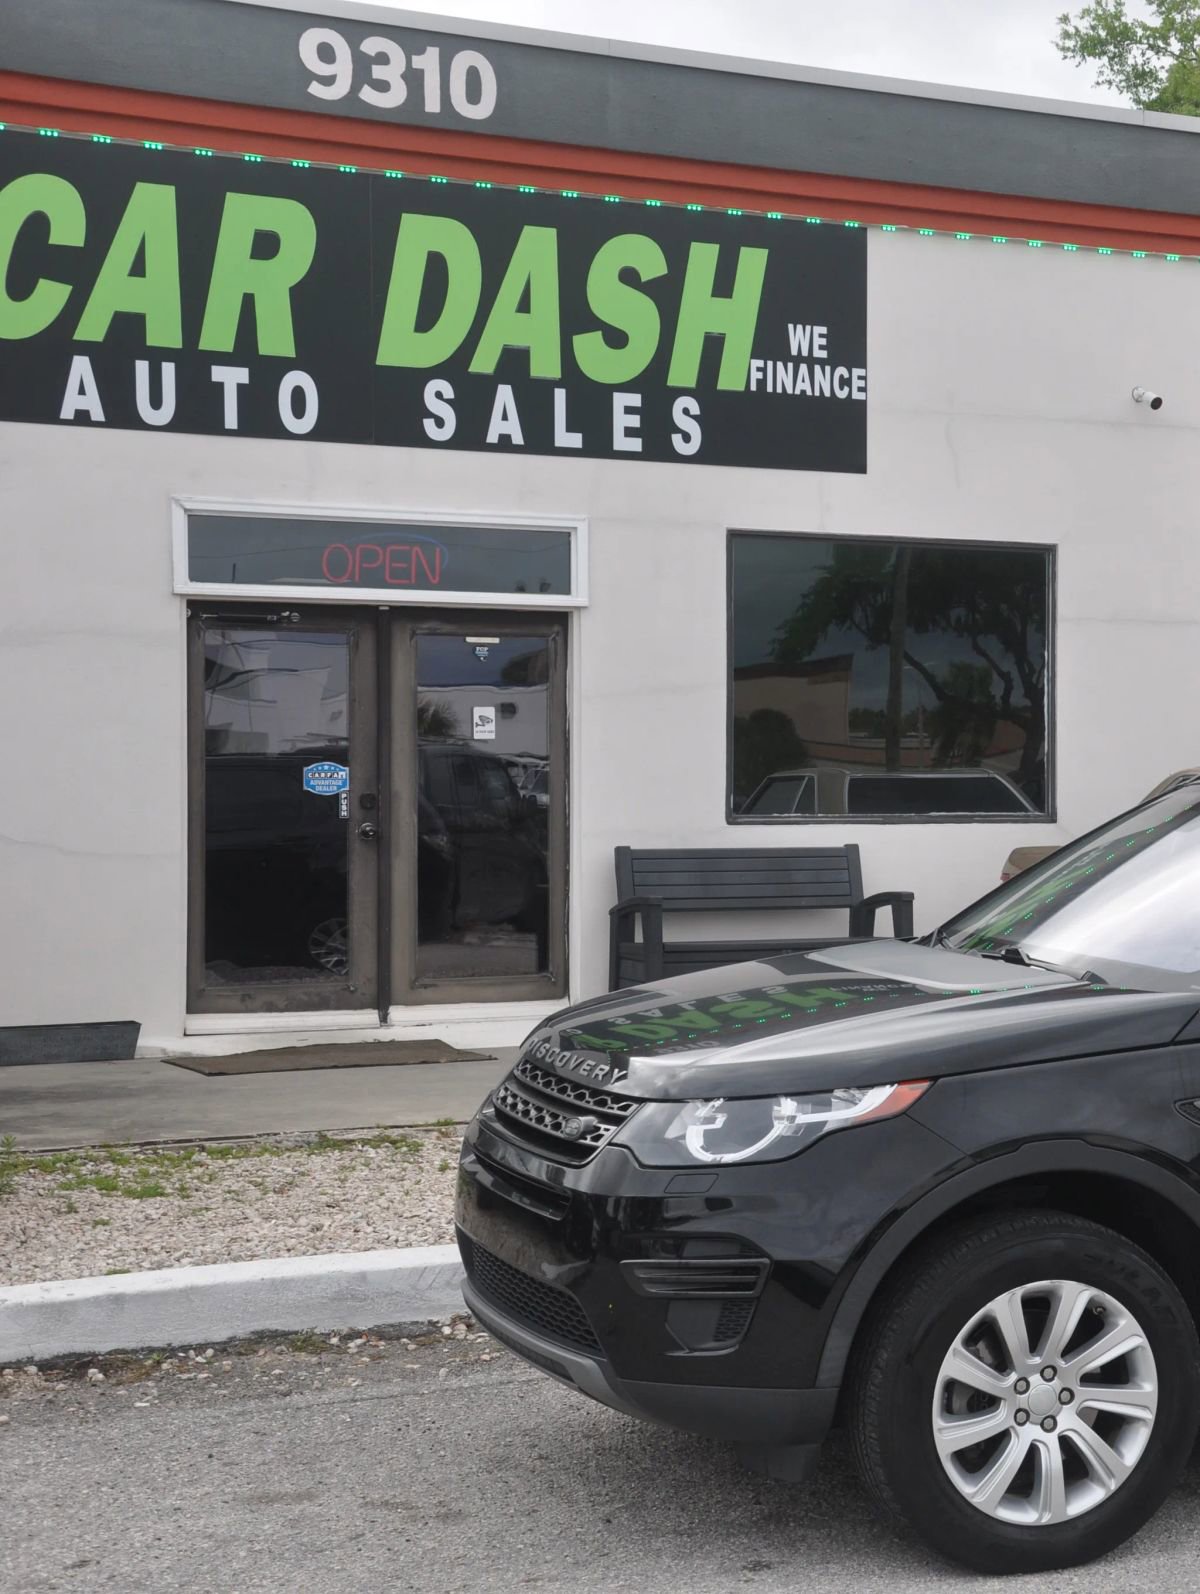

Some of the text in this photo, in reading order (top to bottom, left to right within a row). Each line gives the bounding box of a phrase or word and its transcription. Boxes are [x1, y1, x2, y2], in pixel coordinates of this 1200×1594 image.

[298, 27, 498, 120] 9310
[0, 173, 769, 391] CAR DASH
[787, 323, 828, 358] WE
[60, 355, 702, 456] AUTO SALES
[750, 358, 867, 400] FINANCE
[322, 543, 441, 585] OPEN
